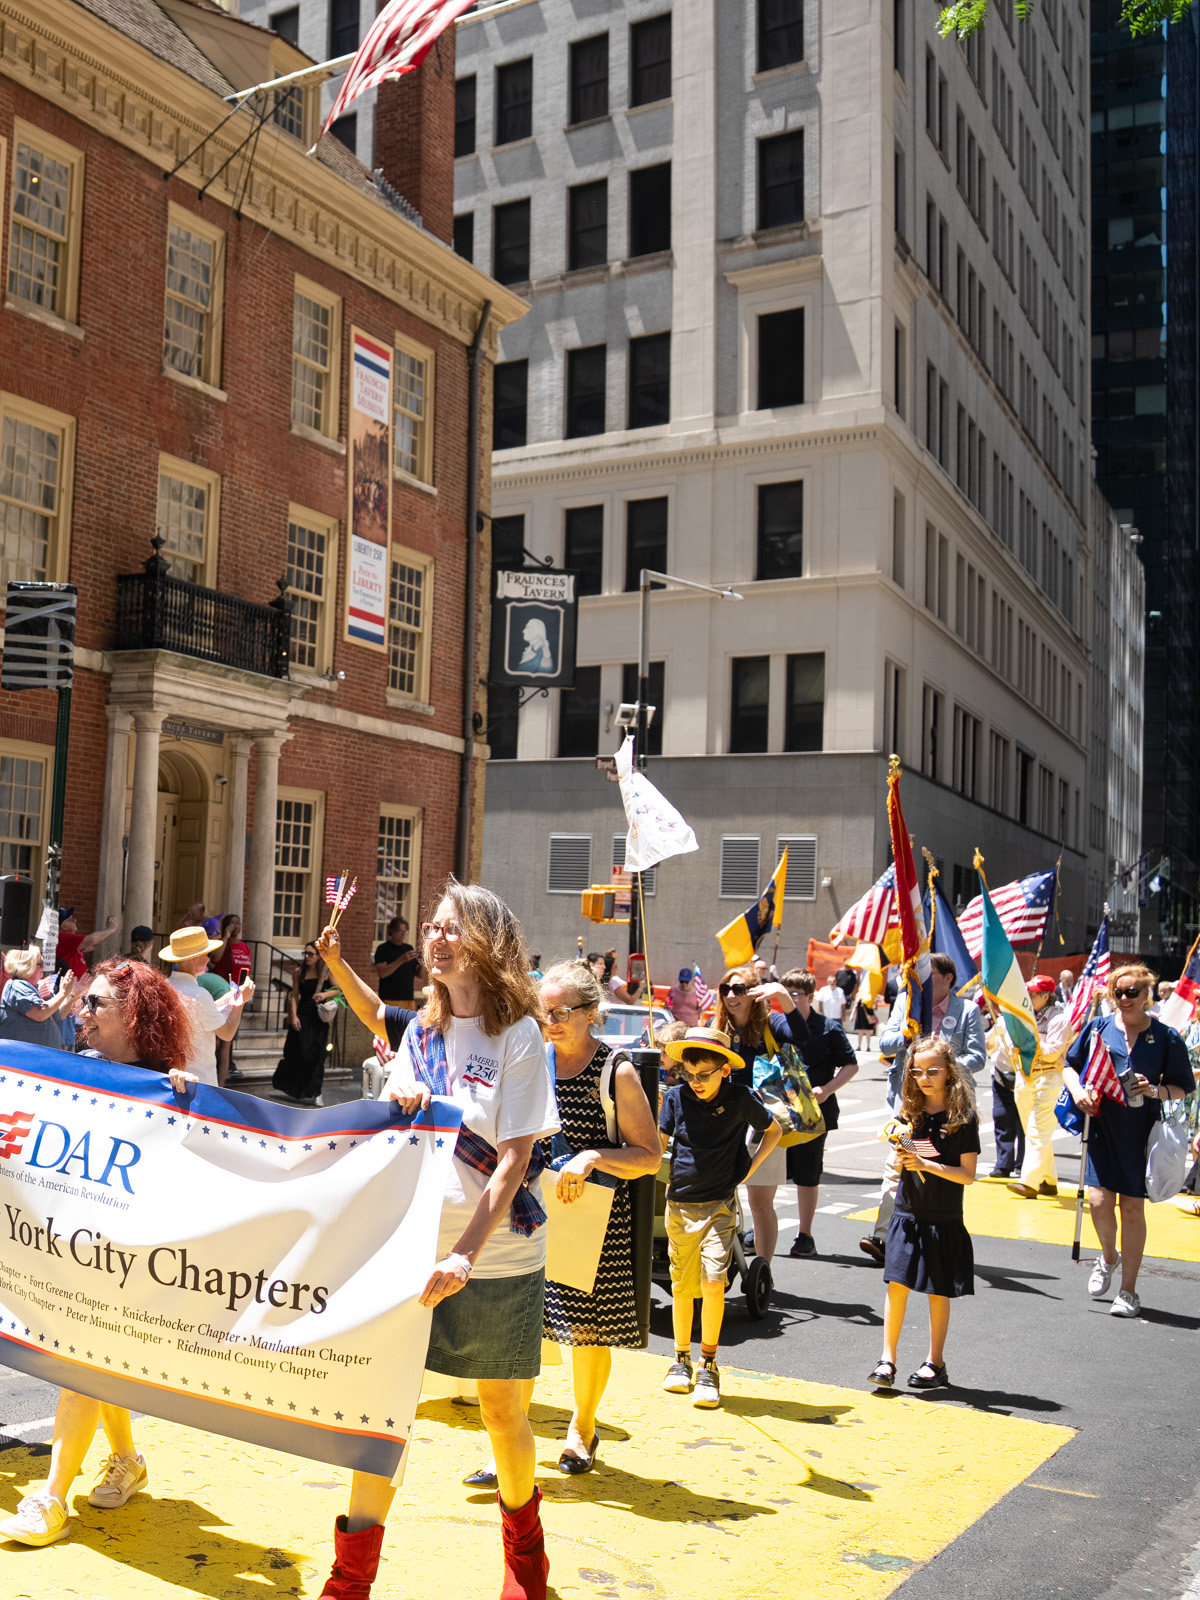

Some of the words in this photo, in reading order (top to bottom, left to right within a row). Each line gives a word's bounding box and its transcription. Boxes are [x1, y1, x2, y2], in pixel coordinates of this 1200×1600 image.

[507, 573, 566, 587] FRAUNCES
[522, 585, 565, 599] TAVERN
[15, 1170, 25, 1182] of
[24, 1172, 36, 1185] the
[38, 1177, 79, 1197] American
[80, 1187, 130, 1211] Revolution
[25, 1120, 141, 1195] DAR
[4, 1203, 63, 1258] York
[69, 1228, 138, 1289] City
[148, 1247, 329, 1314] Chapters
[13, 1284, 27, 1301] City
[28, 1291, 56, 1311] Chapter
[66, 1306, 88, 1323] Peter
[89, 1314, 121, 1333] Minuit
[123, 1324, 163, 1344] Chapter
[176, 1338, 231, 1362] Richmond
[234, 1352, 277, 1373] County
[279, 1360, 329, 1380] Chapter
[29, 1274, 44, 1290] Fort
[45, 1281, 74, 1300] Greene
[75, 1291, 109, 1311] Chapter
[122, 1305, 195, 1333] Knickerbocker
[197, 1323, 241, 1344] Chapter
[249, 1334, 316, 1358] Manhattan
[319, 1347, 372, 1367] Chapter
